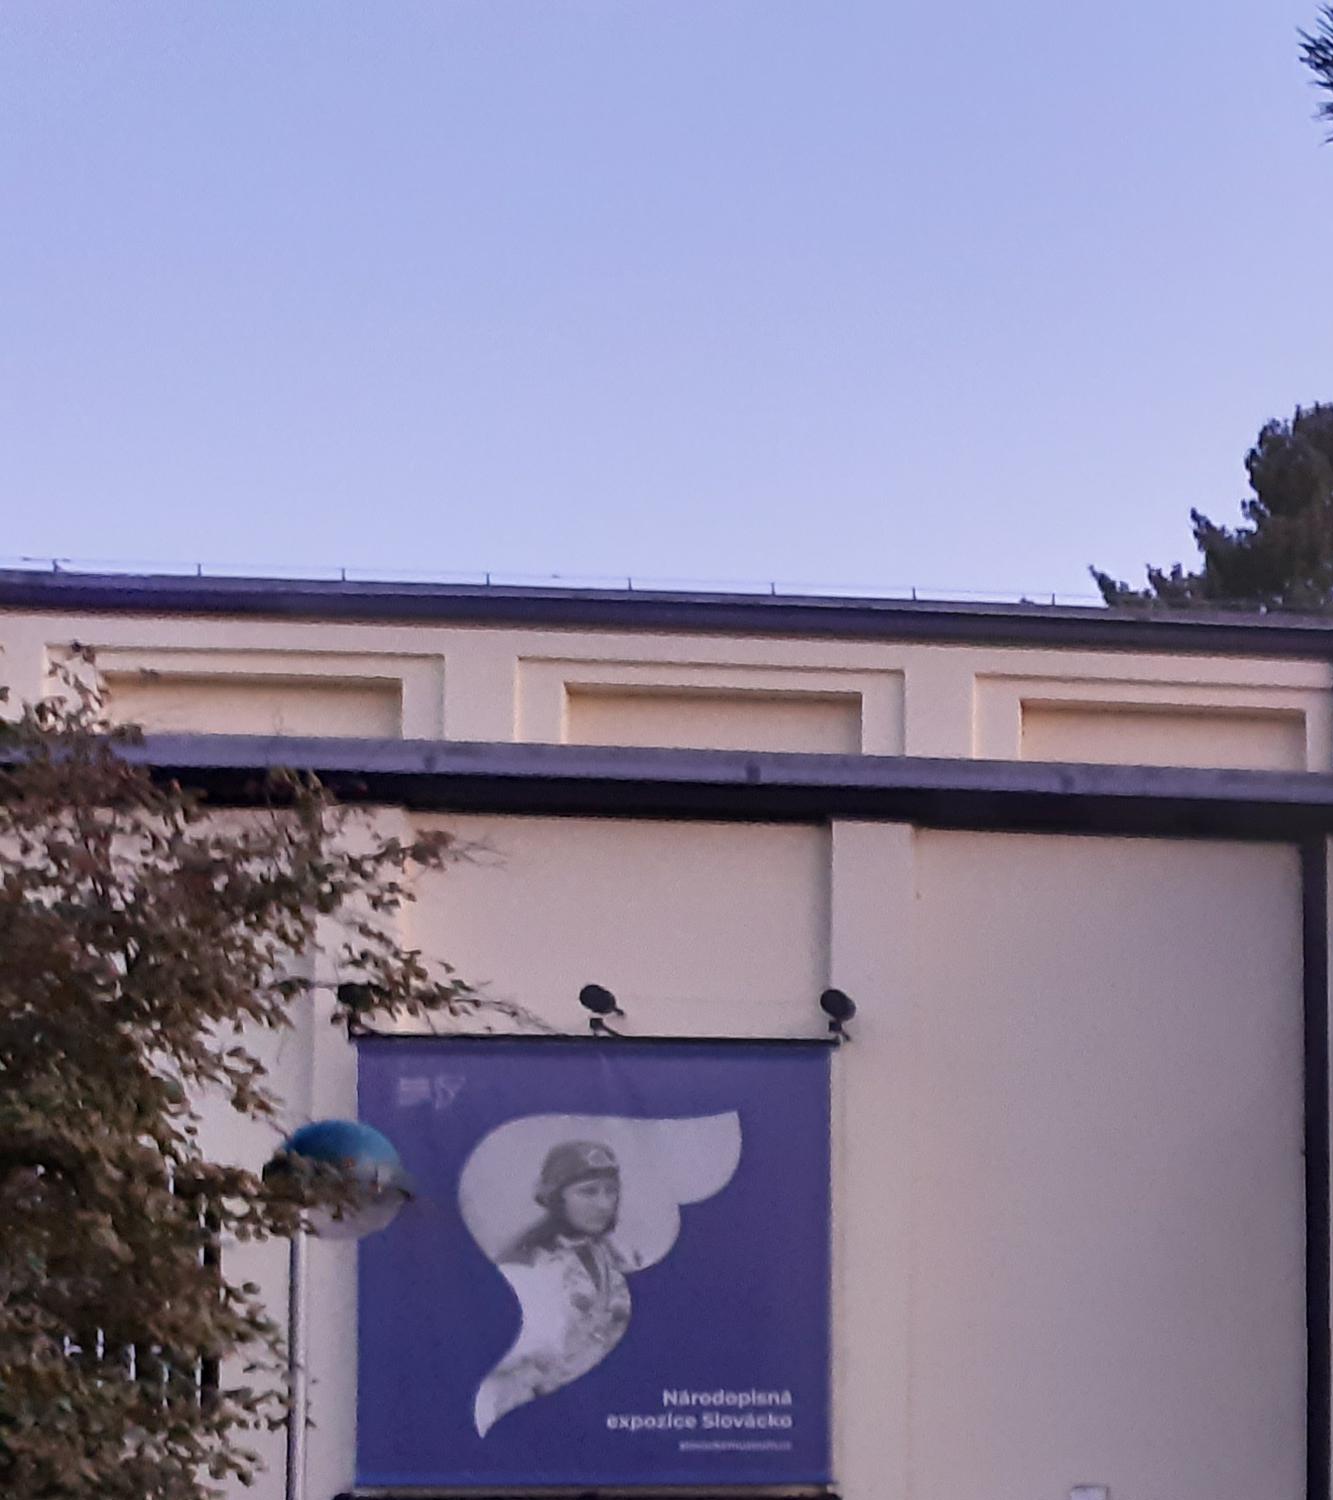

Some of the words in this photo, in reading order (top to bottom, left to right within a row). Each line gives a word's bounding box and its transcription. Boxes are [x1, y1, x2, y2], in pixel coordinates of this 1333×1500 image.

[663, 1388, 792, 1408] Národopisná
[607, 1412, 697, 1431] expozice
[702, 1411, 792, 1429] Slovácko
